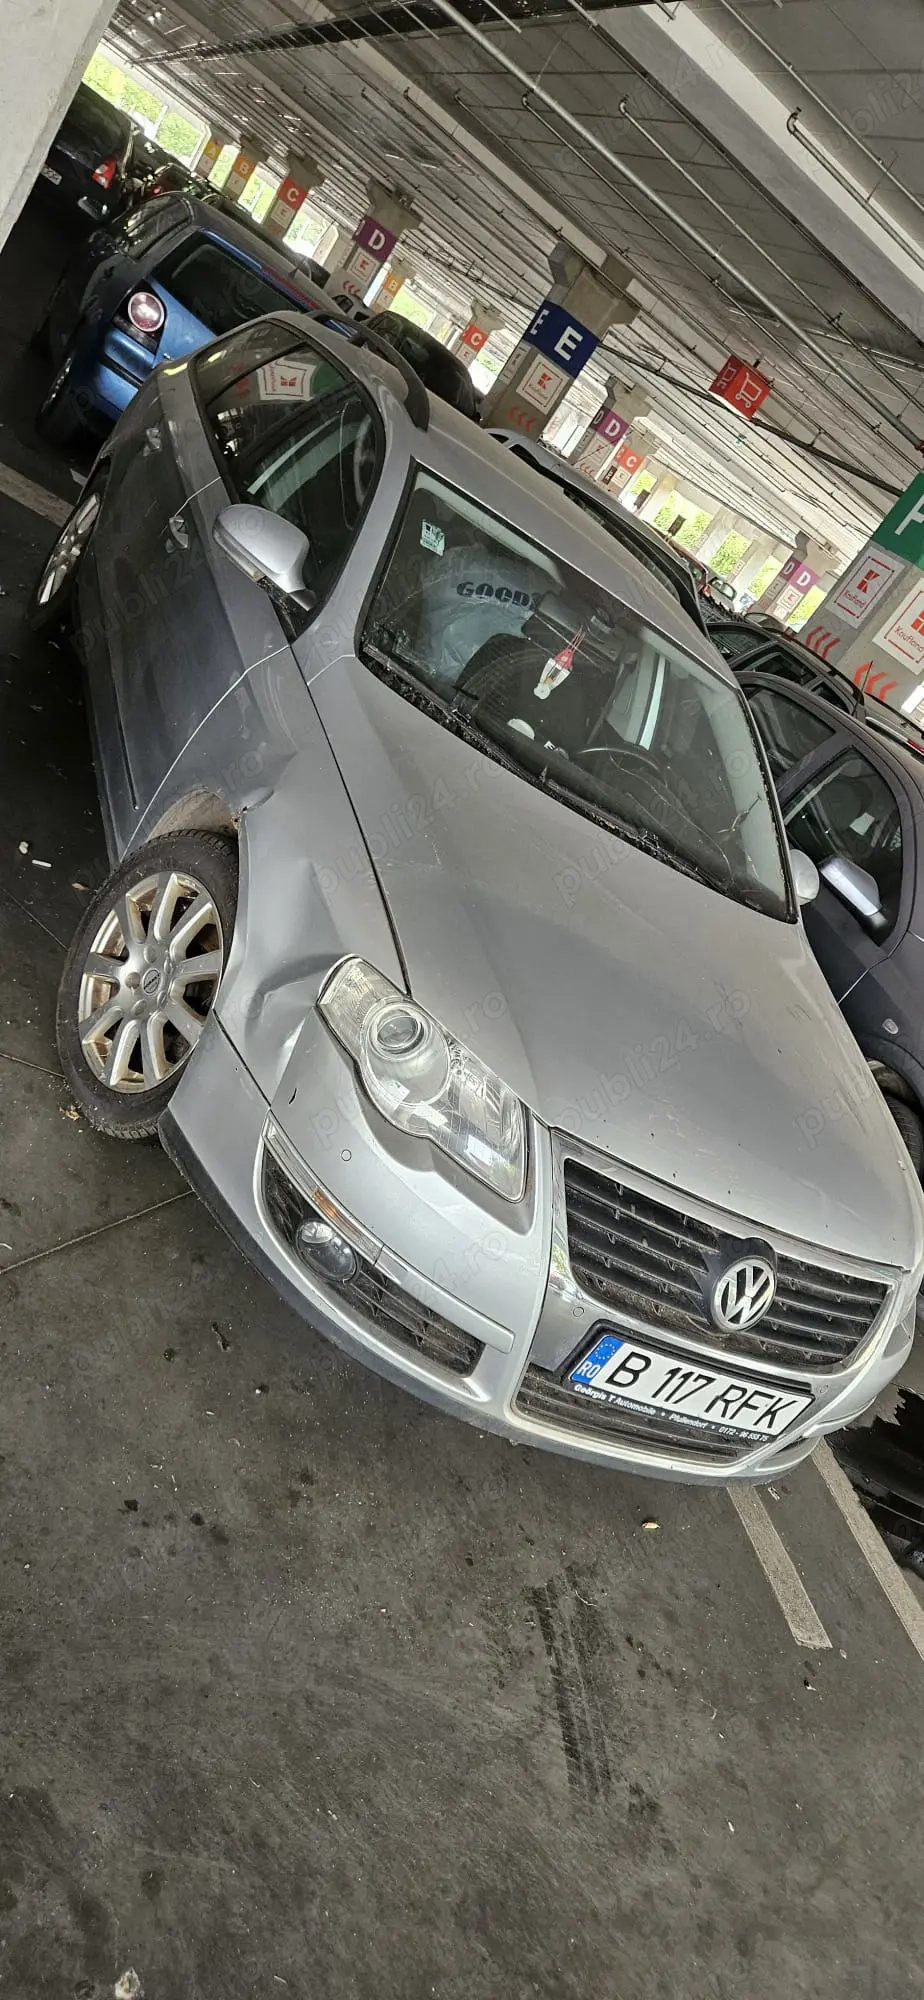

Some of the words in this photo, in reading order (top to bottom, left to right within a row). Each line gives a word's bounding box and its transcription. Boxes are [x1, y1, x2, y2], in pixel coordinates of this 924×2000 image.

[240, 162, 249, 174] B
[287, 187, 300, 201] C
[367, 228, 386, 250] D
[470, 332, 482, 346] C
[553, 325, 584, 361] E
[604, 419, 621, 437] D
[626, 456, 637, 467] C
[783, 562, 795, 575] D
[796, 571, 811, 587] D
[577, 1360, 600, 1379] RO
[604, 1350, 652, 1389] B
[651, 1366, 717, 1405] 117
[703, 1384, 798, 1429] RFK
[718, 1426, 737, 1436] 0172
